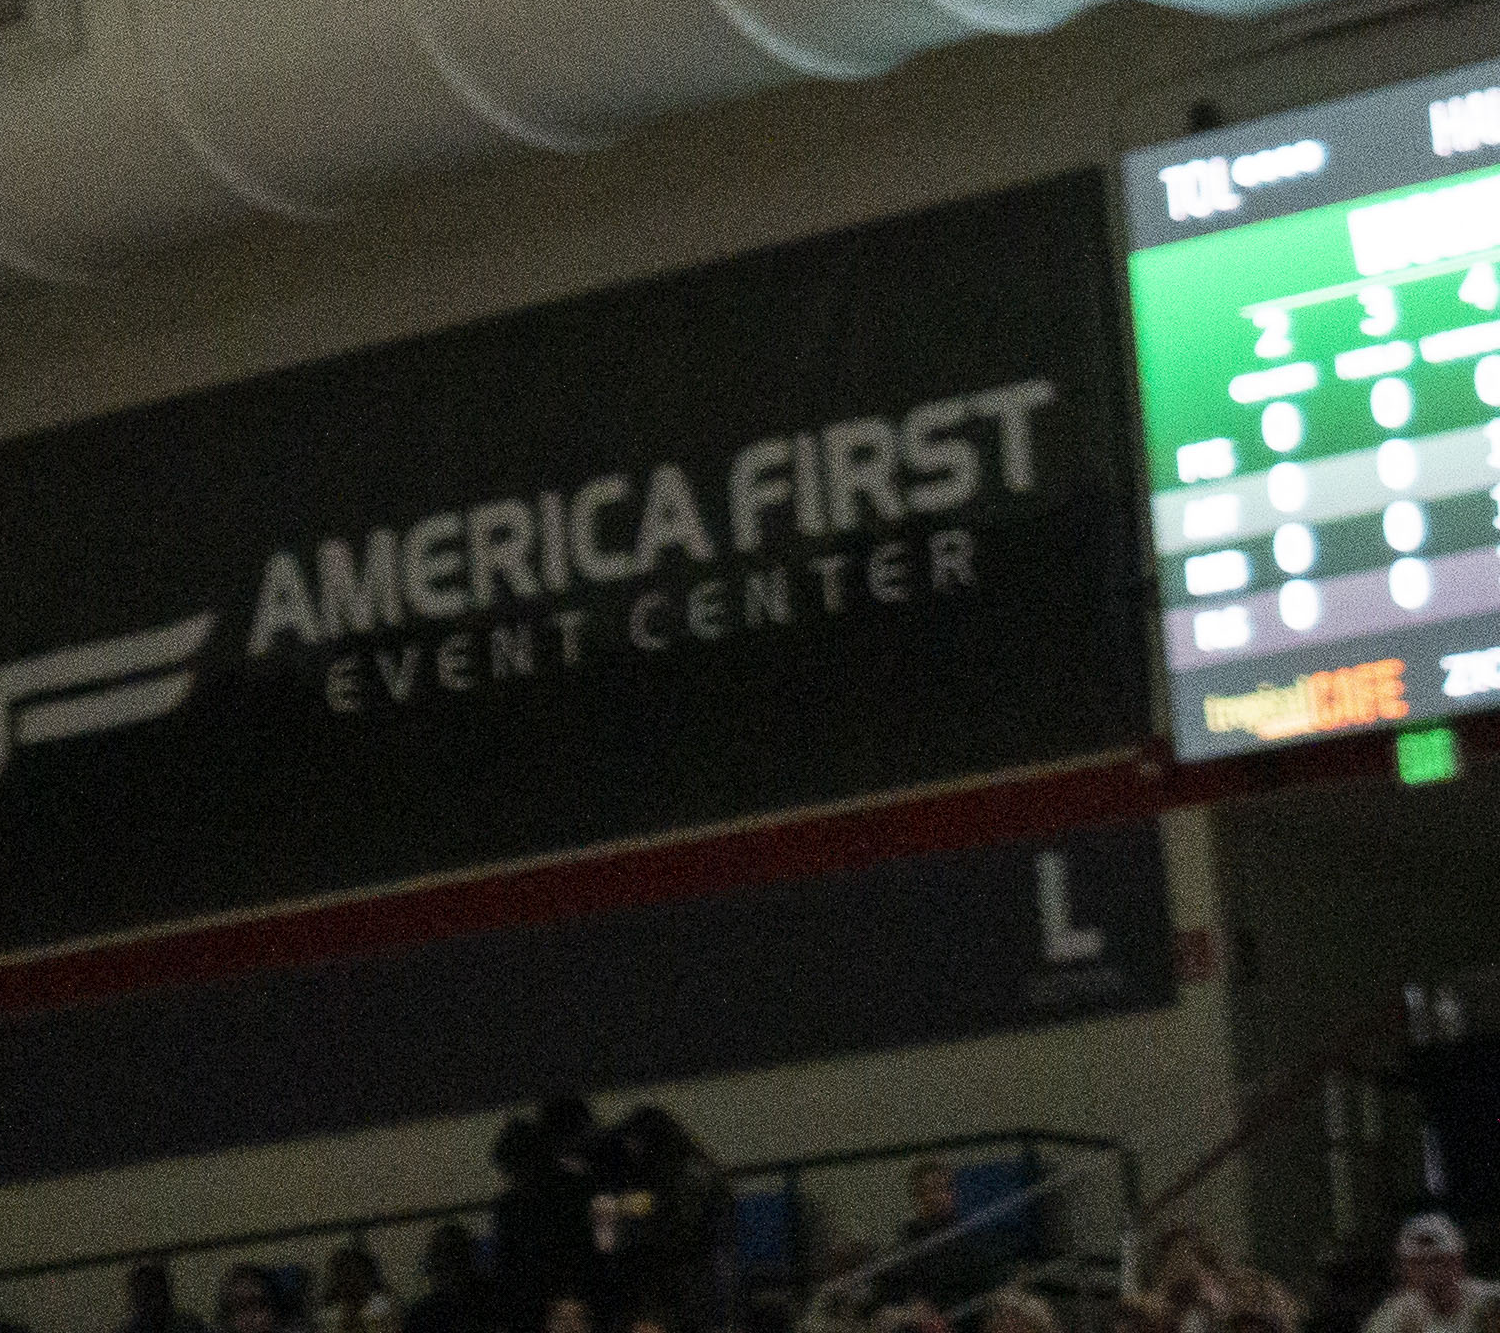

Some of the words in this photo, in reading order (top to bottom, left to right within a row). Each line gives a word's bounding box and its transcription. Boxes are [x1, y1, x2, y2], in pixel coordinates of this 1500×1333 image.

[245, 461, 713, 659] AMERICA
[727, 377, 1056, 553] FIRST
[324, 609, 587, 714] EVENT
[629, 529, 979, 652] CENTER
[1033, 850, 1107, 963] L
